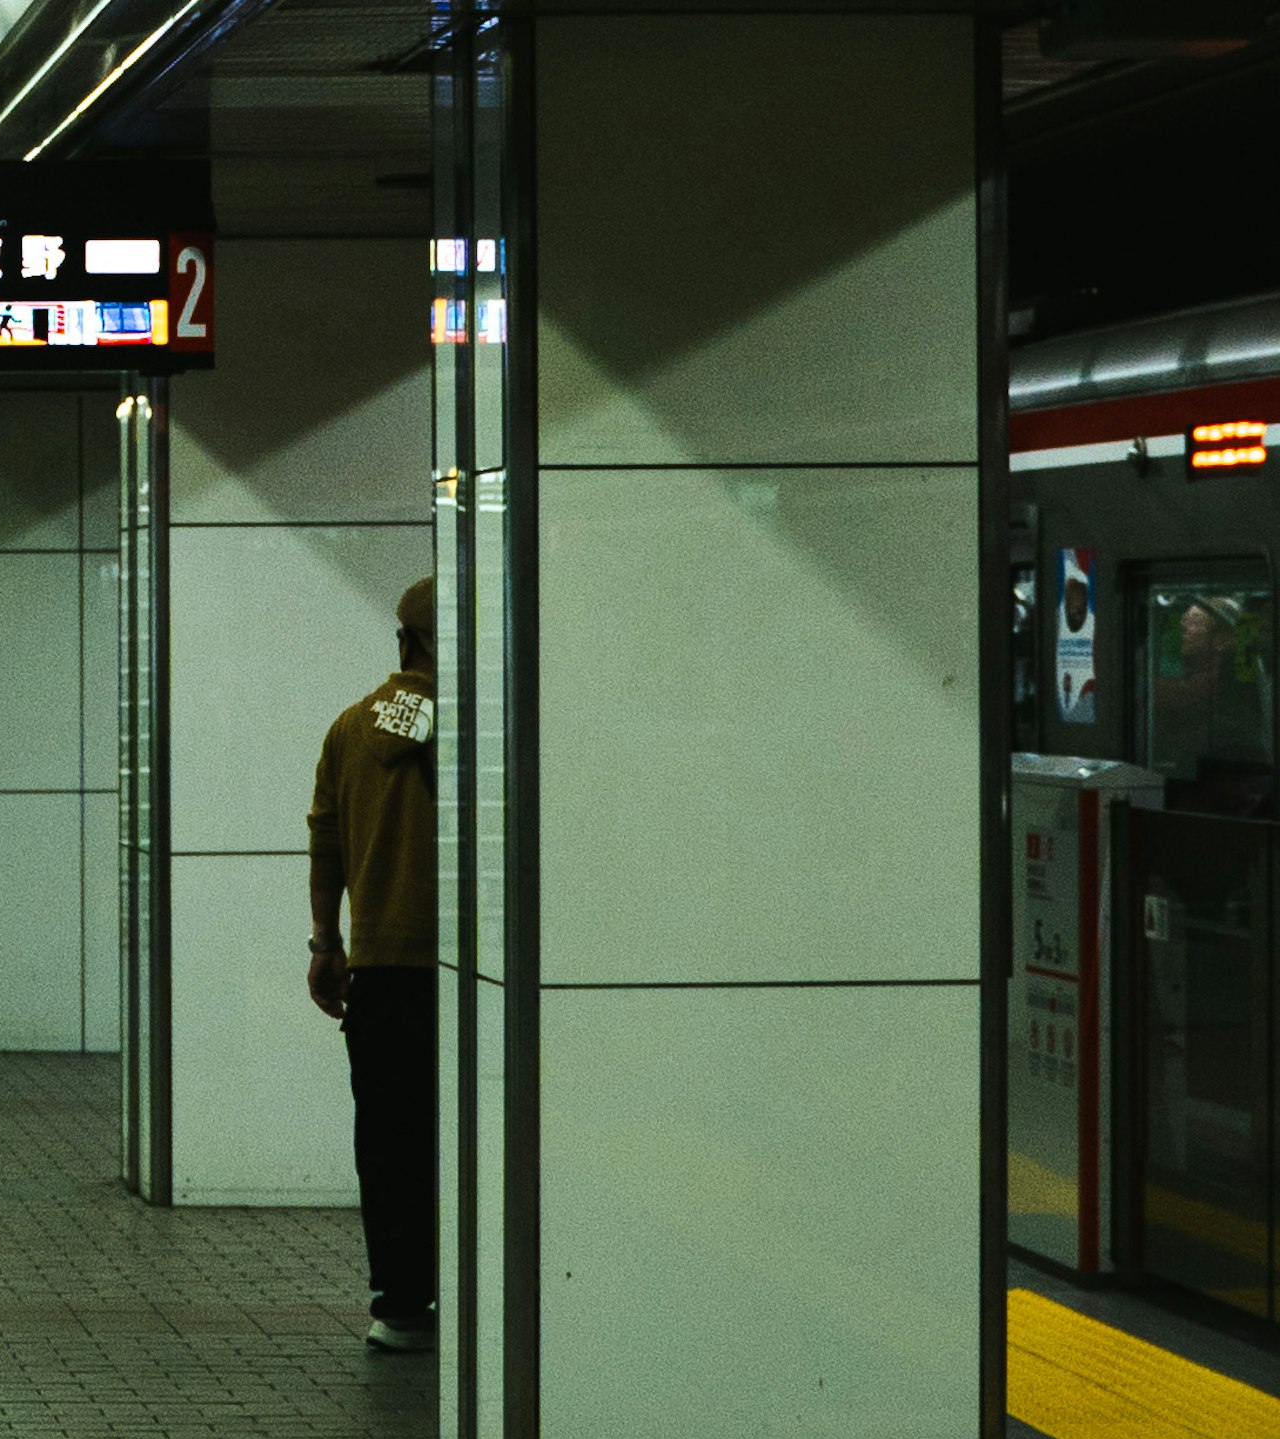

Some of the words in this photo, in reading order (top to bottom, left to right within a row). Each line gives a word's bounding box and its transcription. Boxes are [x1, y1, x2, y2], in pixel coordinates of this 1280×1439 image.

[176, 246, 207, 338] 2
[393, 689, 422, 709] THE
[369, 700, 417, 723] NORTH
[373, 714, 410, 738] FACE
